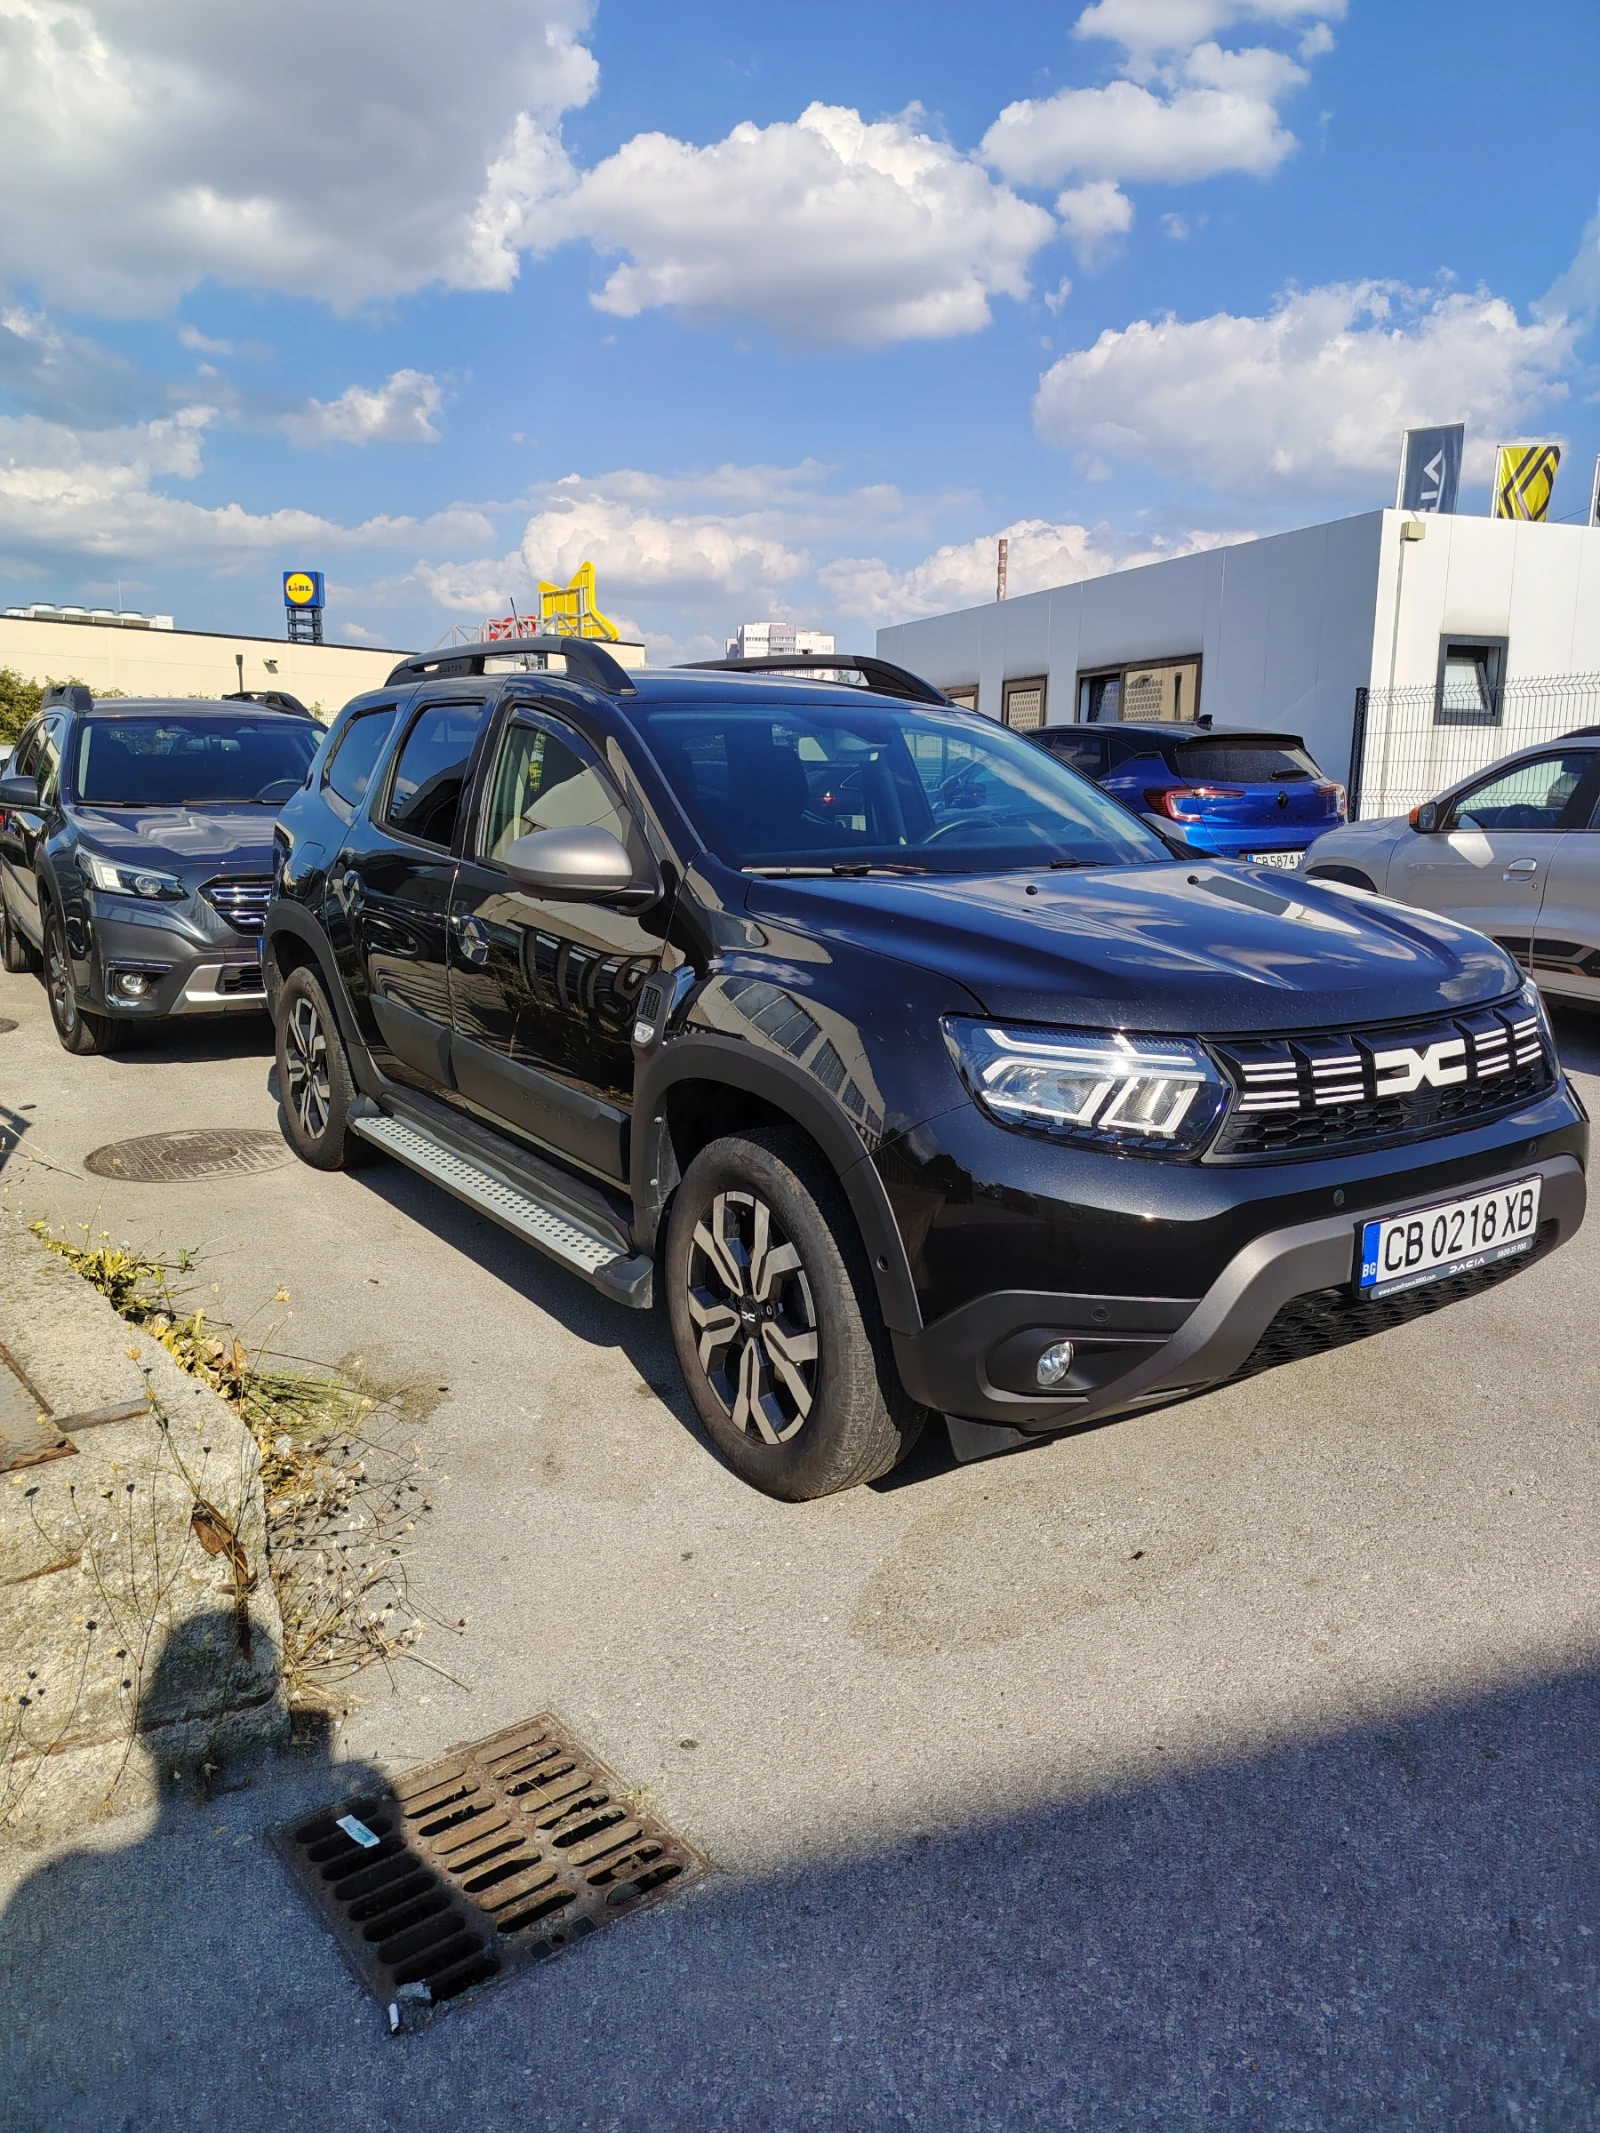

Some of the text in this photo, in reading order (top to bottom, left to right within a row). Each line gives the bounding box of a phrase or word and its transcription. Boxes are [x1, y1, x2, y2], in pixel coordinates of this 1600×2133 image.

[1270, 855, 1294, 868] 5874
[1385, 1189, 1533, 1272] CB 0218 XB
[1362, 1262, 1377, 1278] BG
[1449, 1257, 1485, 1274] DACIA
